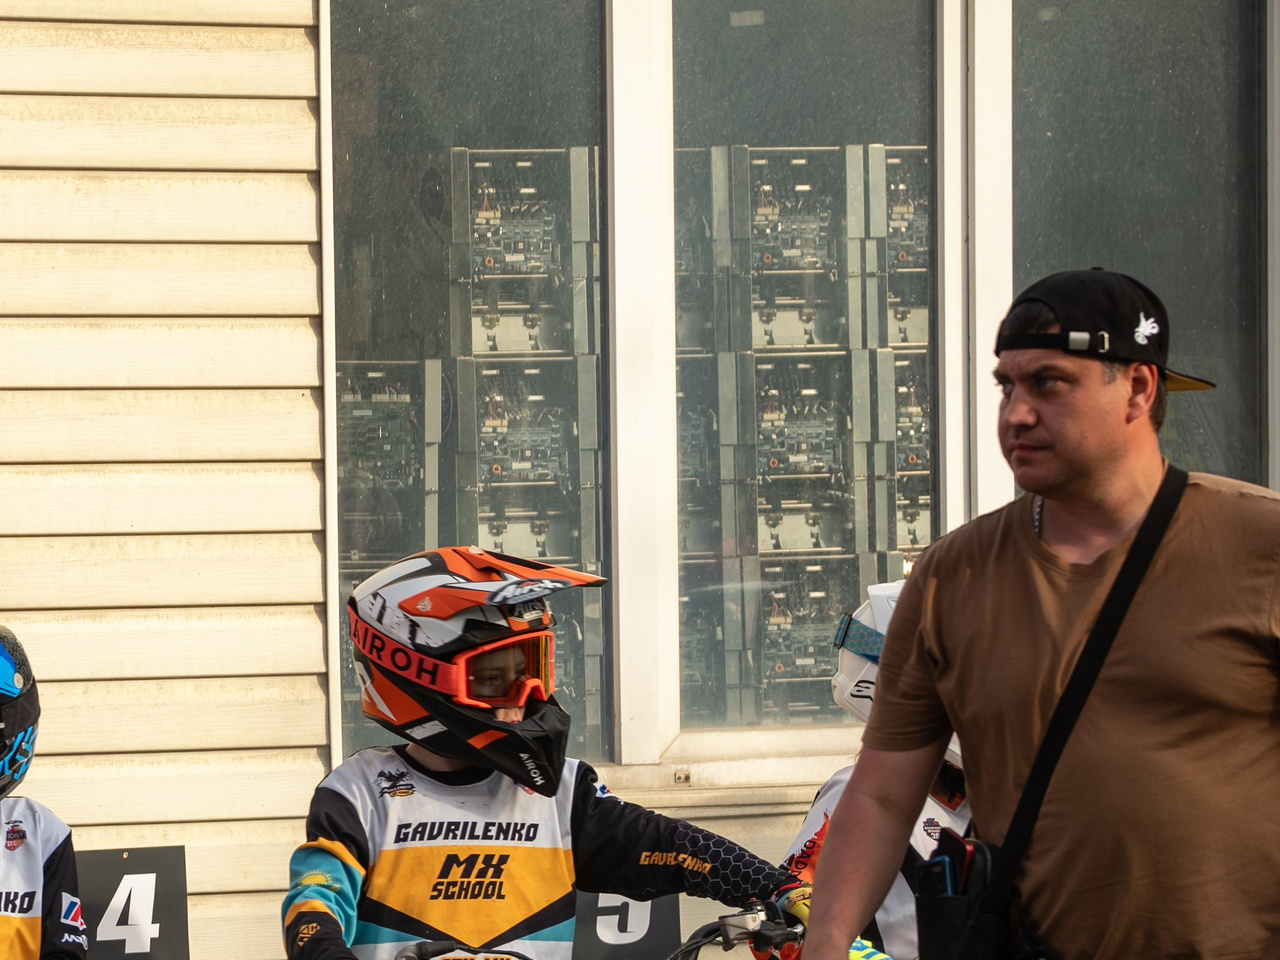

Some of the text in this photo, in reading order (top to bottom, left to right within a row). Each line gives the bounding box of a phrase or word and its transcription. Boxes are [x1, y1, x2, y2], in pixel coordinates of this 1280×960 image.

[352, 620, 440, 686] AIROH
[519, 753, 546, 786] AIROH
[394, 821, 539, 844] GAVRILENKO
[437, 854, 511, 879] MX
[429, 881, 507, 900] SCHOOL
[96, 872, 160, 954] 4
[595, 892, 652, 945] 5
